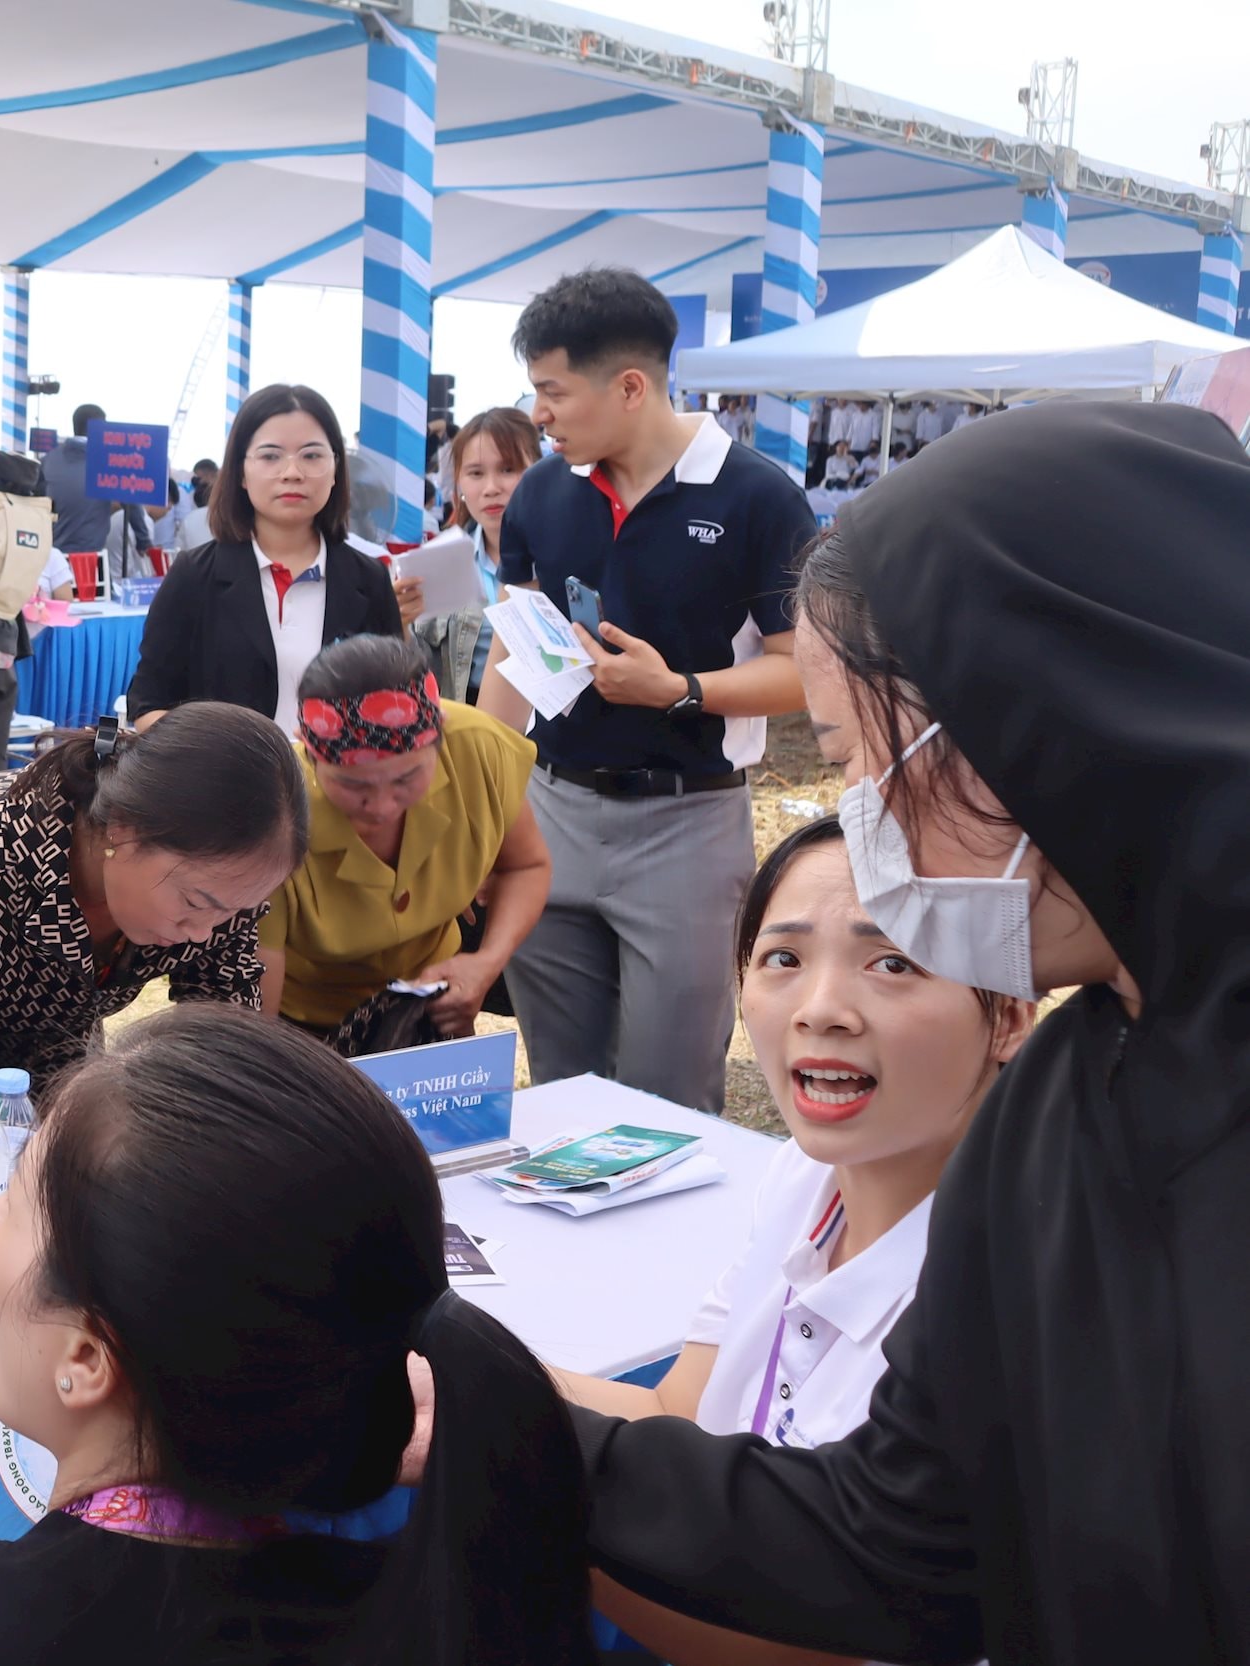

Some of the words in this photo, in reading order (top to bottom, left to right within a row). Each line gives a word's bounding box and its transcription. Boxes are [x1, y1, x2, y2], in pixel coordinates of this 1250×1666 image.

[97, 472, 118, 488] LAO
[688, 525, 716, 539] WHA
[396, 1086, 409, 1102] ty
[413, 1074, 457, 1096] TNHH
[461, 1065, 491, 1086] Giầy
[400, 1105, 417, 1120] ess
[421, 1098, 448, 1116] Việt
[451, 1094, 482, 1110] Nam
[9, 1462, 30, 1494] ĐỘNG
[29, 1495, 47, 1513] LAO
